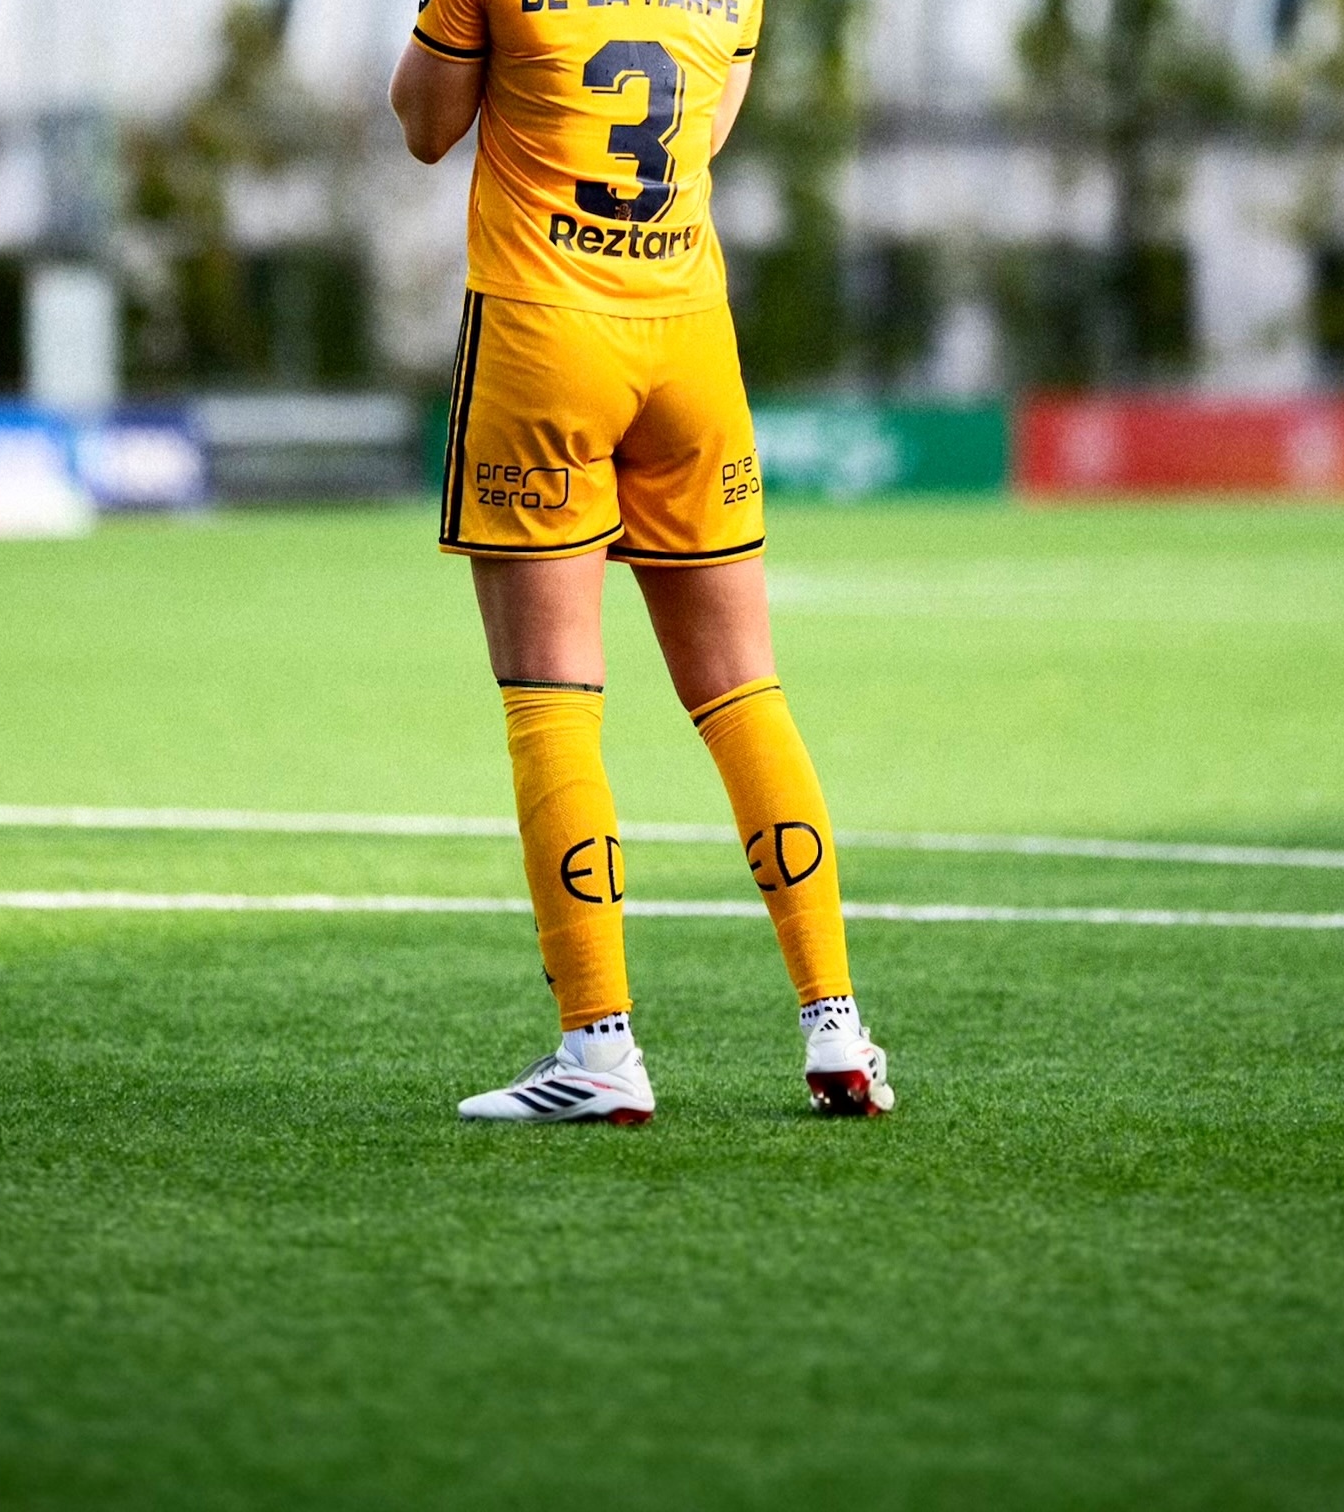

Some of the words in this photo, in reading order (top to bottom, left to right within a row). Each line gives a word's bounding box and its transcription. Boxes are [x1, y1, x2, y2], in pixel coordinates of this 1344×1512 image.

[574, 39, 687, 223] 3
[476, 462, 523, 484] pre
[722, 456, 753, 486] pre
[478, 487, 541, 509] zero
